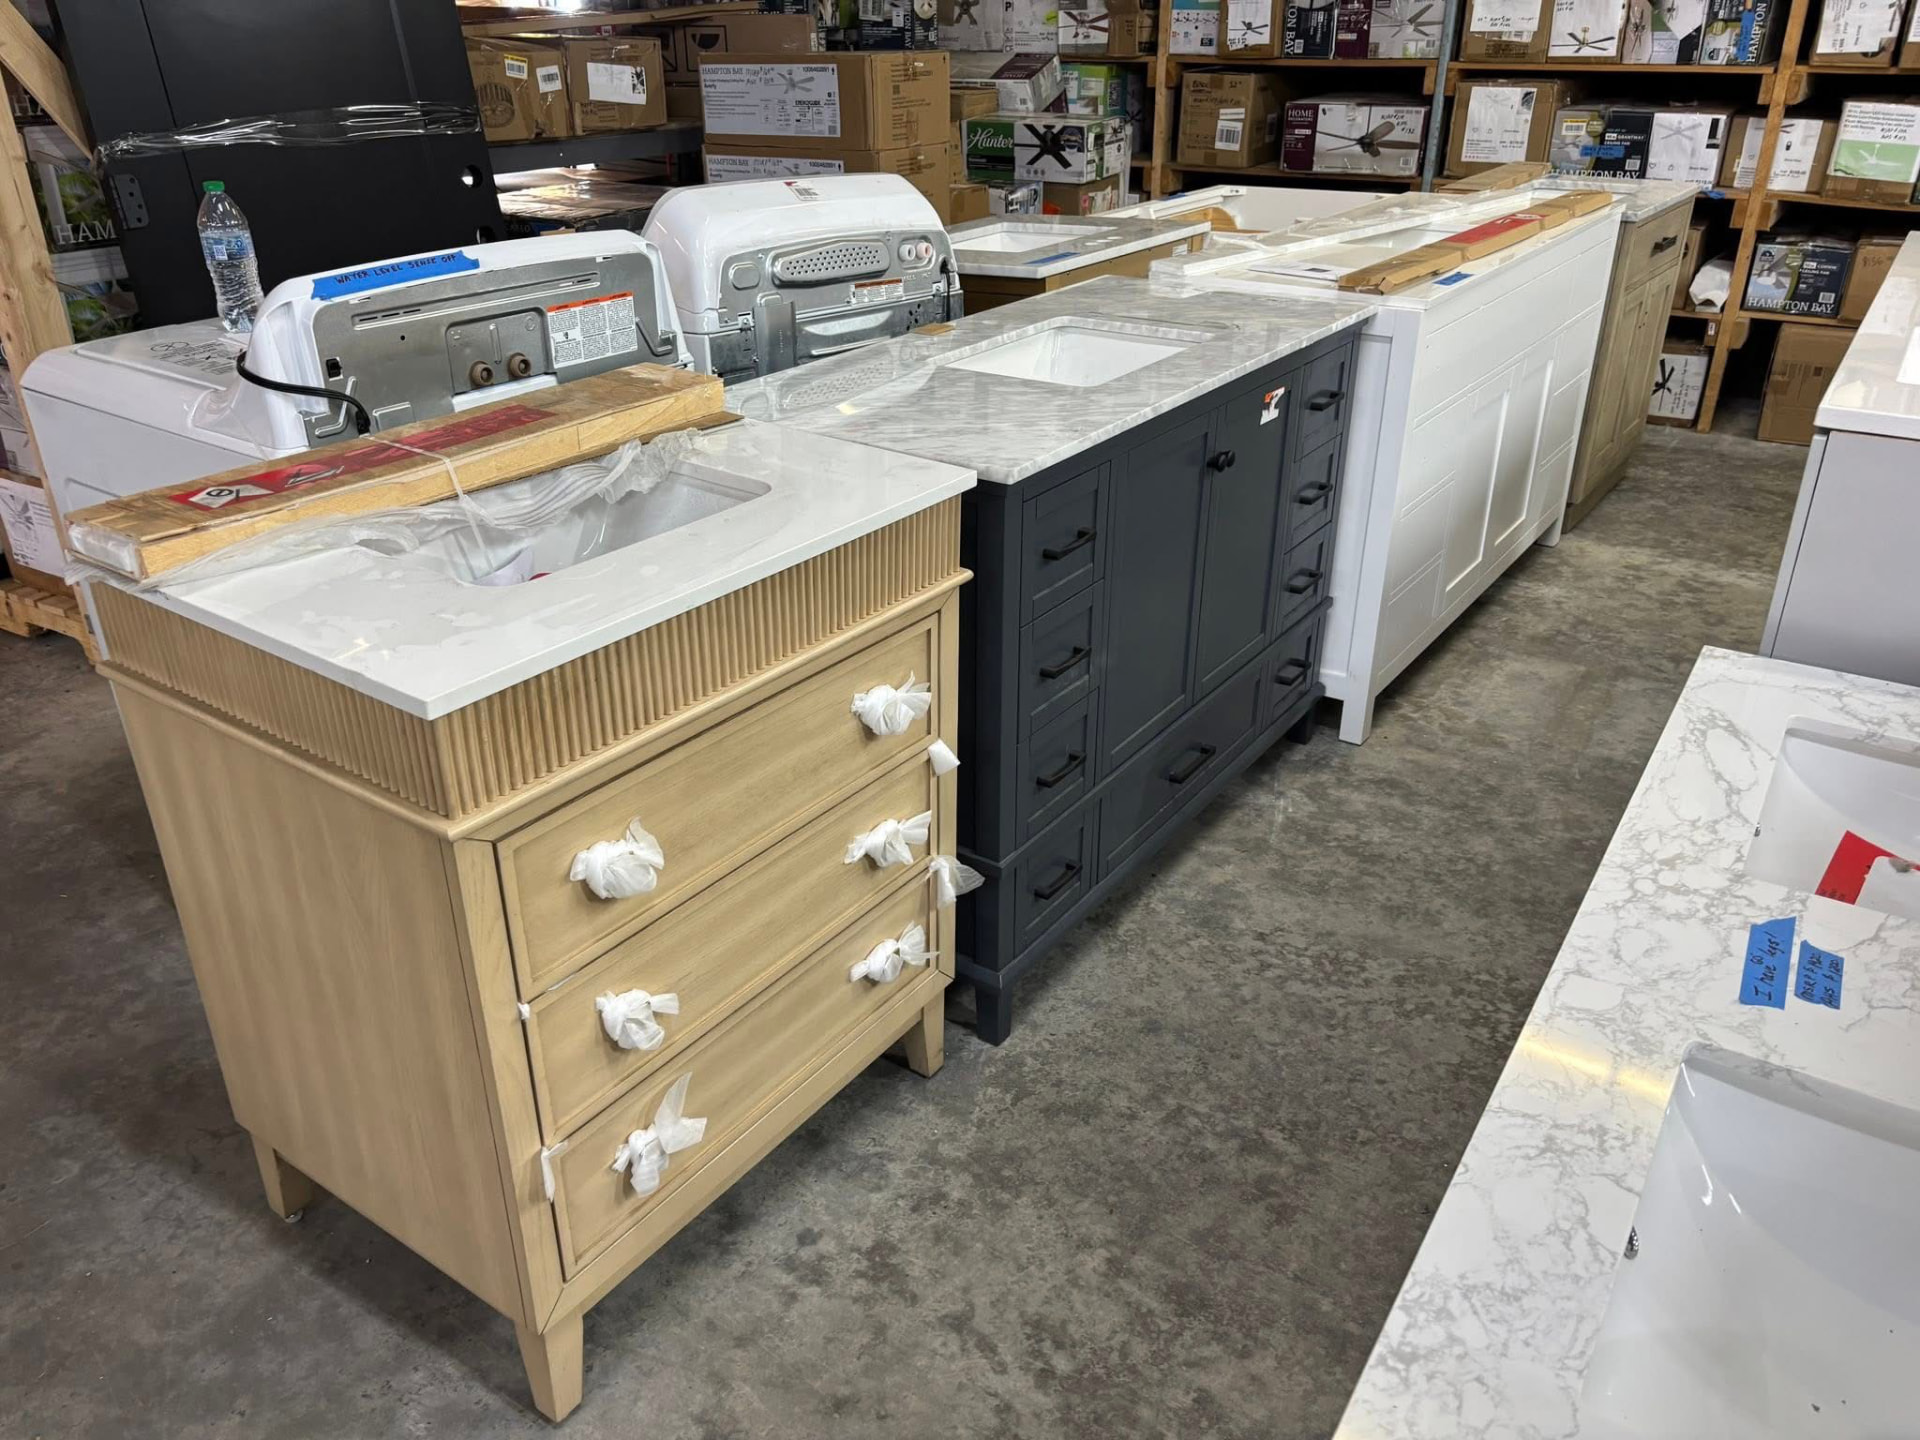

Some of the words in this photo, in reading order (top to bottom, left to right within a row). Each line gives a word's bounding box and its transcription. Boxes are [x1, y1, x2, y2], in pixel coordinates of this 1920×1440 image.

[1284, 31, 1296, 55] BAY
[1746, 2, 1768, 63] HAMPTON
[702, 67, 732, 75] HAMPTON
[732, 67, 744, 75] BAY
[1288, 109, 1314, 117] HOME
[967, 128, 1014, 150] Hunter
[55, 219, 118, 245] HAM
[335, 271, 370, 285] WATER
[374, 265, 403, 277] LEVEL
[408, 258, 437, 270] SENSE
[441, 253, 457, 263] OFF
[1748, 297, 1810, 312] HAMPTON
[1811, 302, 1834, 314] BAY
